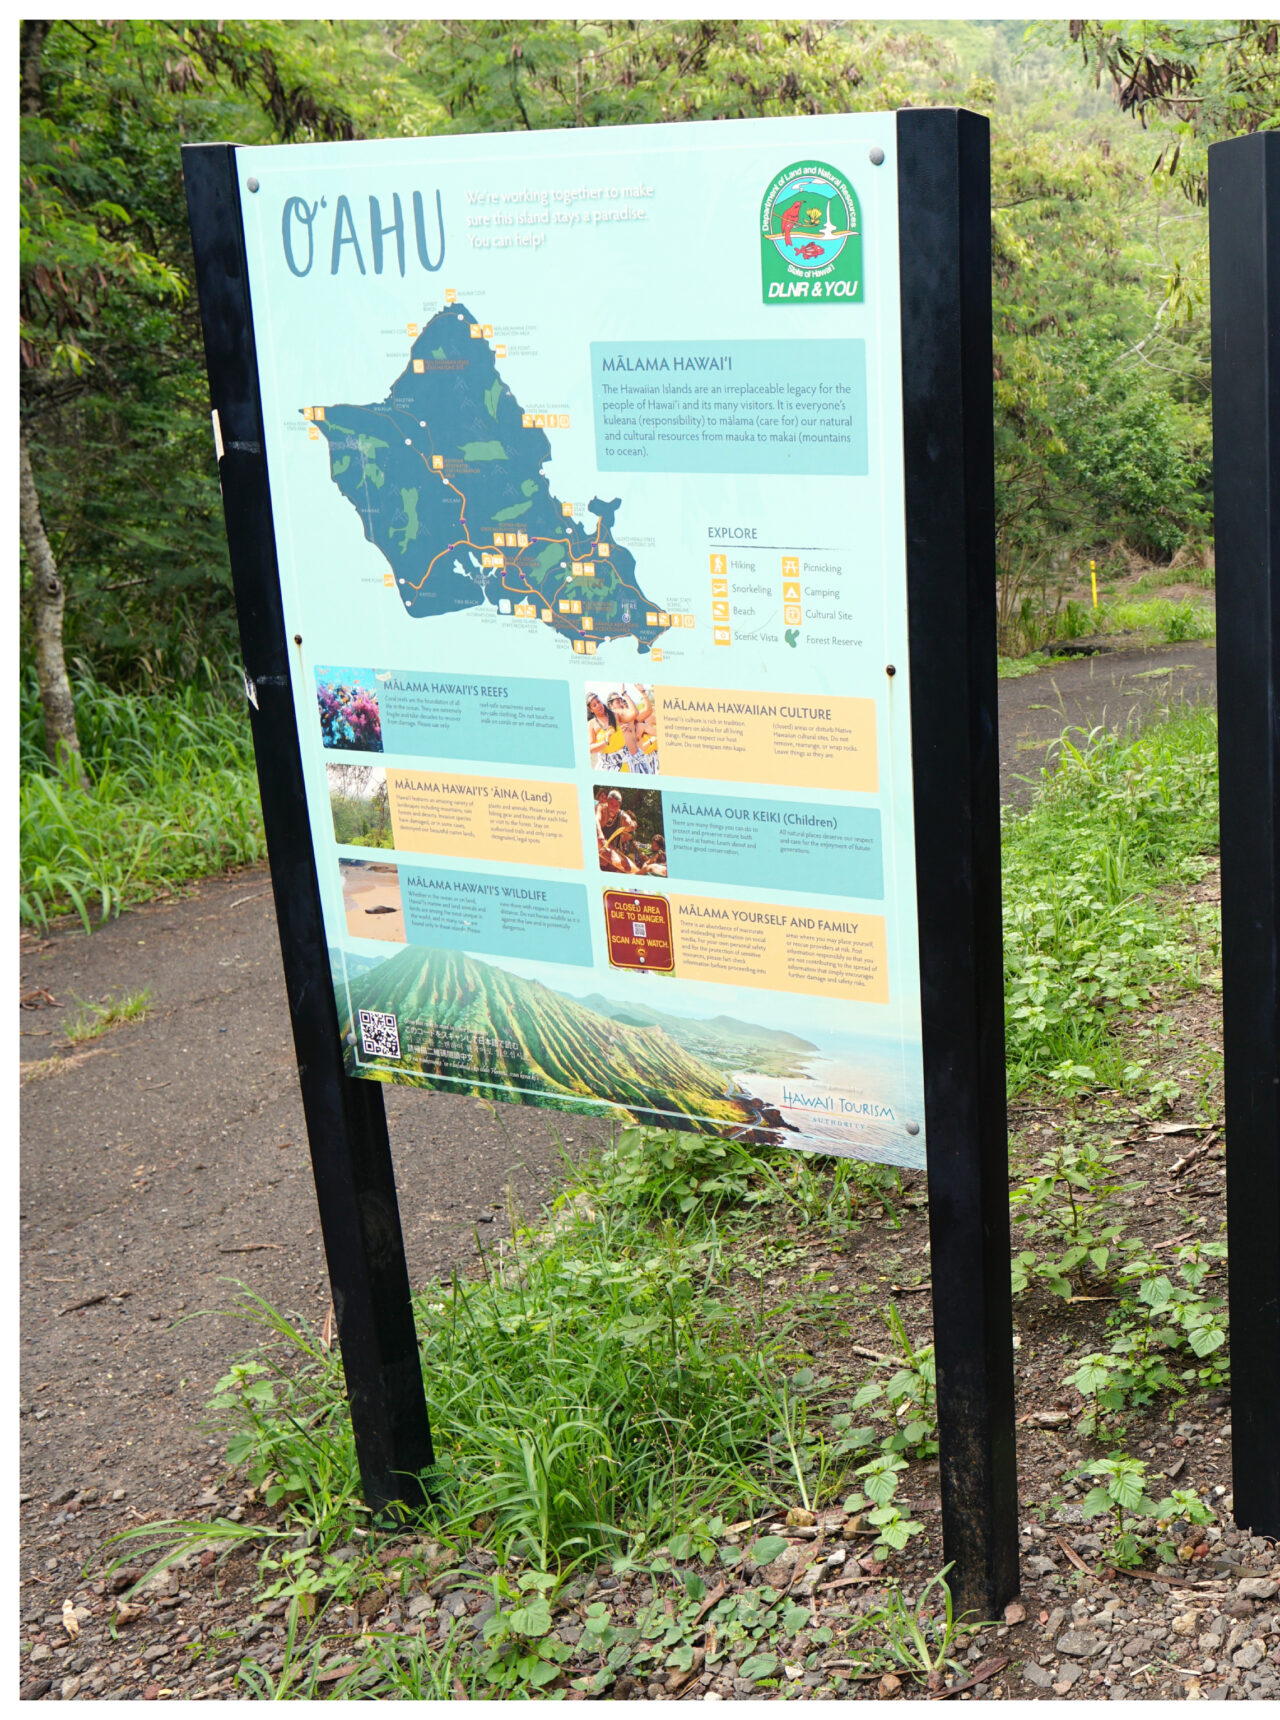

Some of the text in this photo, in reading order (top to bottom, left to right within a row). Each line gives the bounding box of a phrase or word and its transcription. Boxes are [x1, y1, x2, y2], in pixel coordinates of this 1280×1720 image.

[762, 182, 779, 231] Department
[778, 176, 786, 186] of
[784, 168, 802, 180] Land
[818, 168, 842, 185] Natural
[839, 183, 856, 228] Resources
[768, 281, 858, 297] DLNR & YOU
[602, 384, 851, 397] The Hawaiian Islands are an irreplaceable legacy for the
[708, 527, 758, 539] EXPLORE
[731, 561, 755, 572] Hiking
[804, 563, 842, 575] Picnicking
[732, 585, 772, 596] Snorkeling
[805, 587, 840, 599] Camping
[733, 607, 755, 616] Beach
[805, 610, 853, 621] Cultural Site
[735, 632, 779, 642] Scenic Vista
[807, 635, 863, 647] Forest Reserve
[384, 679, 508, 697] MĀLAMA HAWAI'I'S REEFS
[663, 698, 831, 720] MĀLAMA HAWAIIAN CULTURE
[671, 803, 837, 829] MĀLAMA OUR KEIKI (Children)
[408, 876, 547, 901] MĀLAMA HAWAI'I'S WILDLIFE
[615, 902, 660, 914] CLOSED AREA
[611, 911, 665, 923] DUE TO DANGER.
[679, 904, 858, 934] MĀLAMA YOURSELF AND FAMILY
[612, 936, 630, 944] SCAN
[647, 939, 669, 948] WATCH.
[813, 1117, 865, 1129] AUTHORITY
